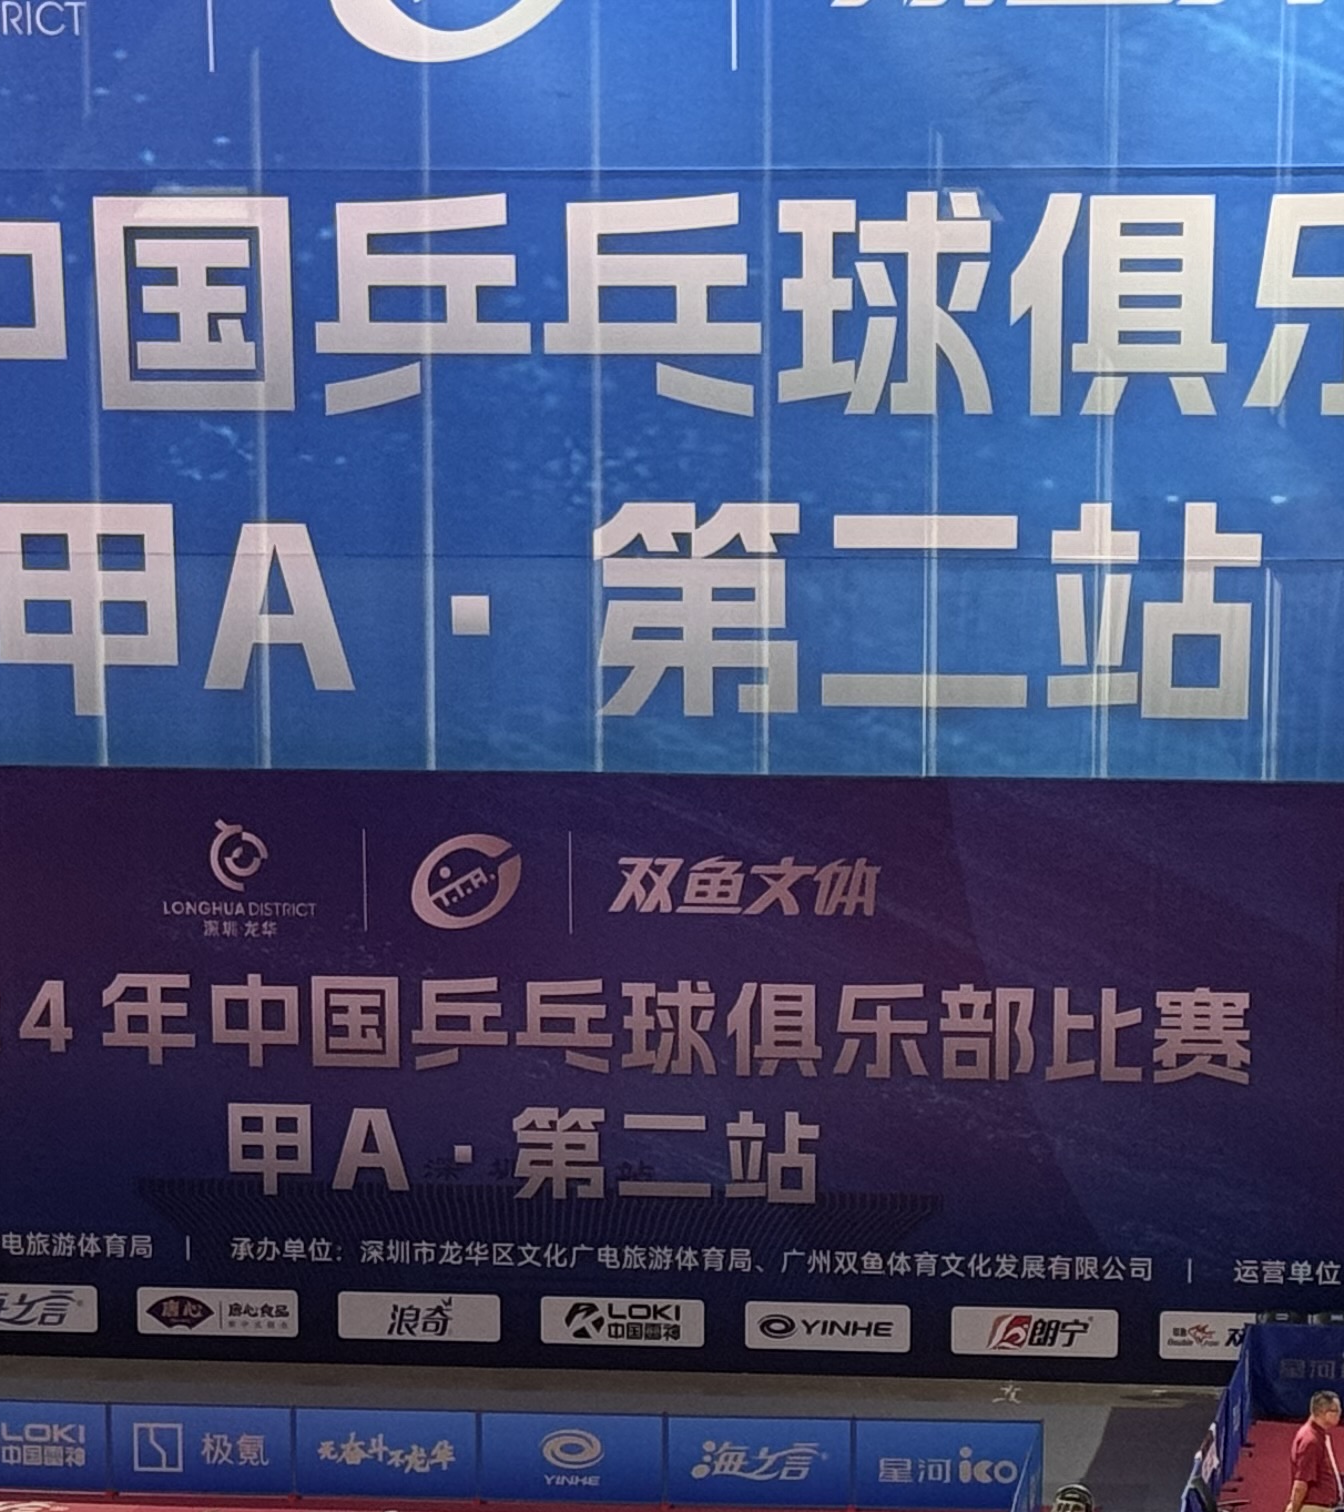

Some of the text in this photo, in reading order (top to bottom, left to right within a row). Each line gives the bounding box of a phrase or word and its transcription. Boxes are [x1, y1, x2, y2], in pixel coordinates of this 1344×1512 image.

[609, 856, 882, 917] 双鱼文体
[162, 901, 317, 918] LONGHUA DISTRICT
[387, 1304, 454, 1338] 浪奇
[607, 1302, 682, 1321] LOKI
[607, 1321, 682, 1342] 中国雷神
[799, 1318, 894, 1338] YINHE
[1027, 1317, 1090, 1349] 朗宁
[0, 1422, 87, 1443] LOKI
[0, 1443, 87, 1468] 中国雷神
[200, 1431, 270, 1468] 极氪
[690, 1440, 821, 1482] 海之言
[543, 1473, 601, 1487] YINHE
